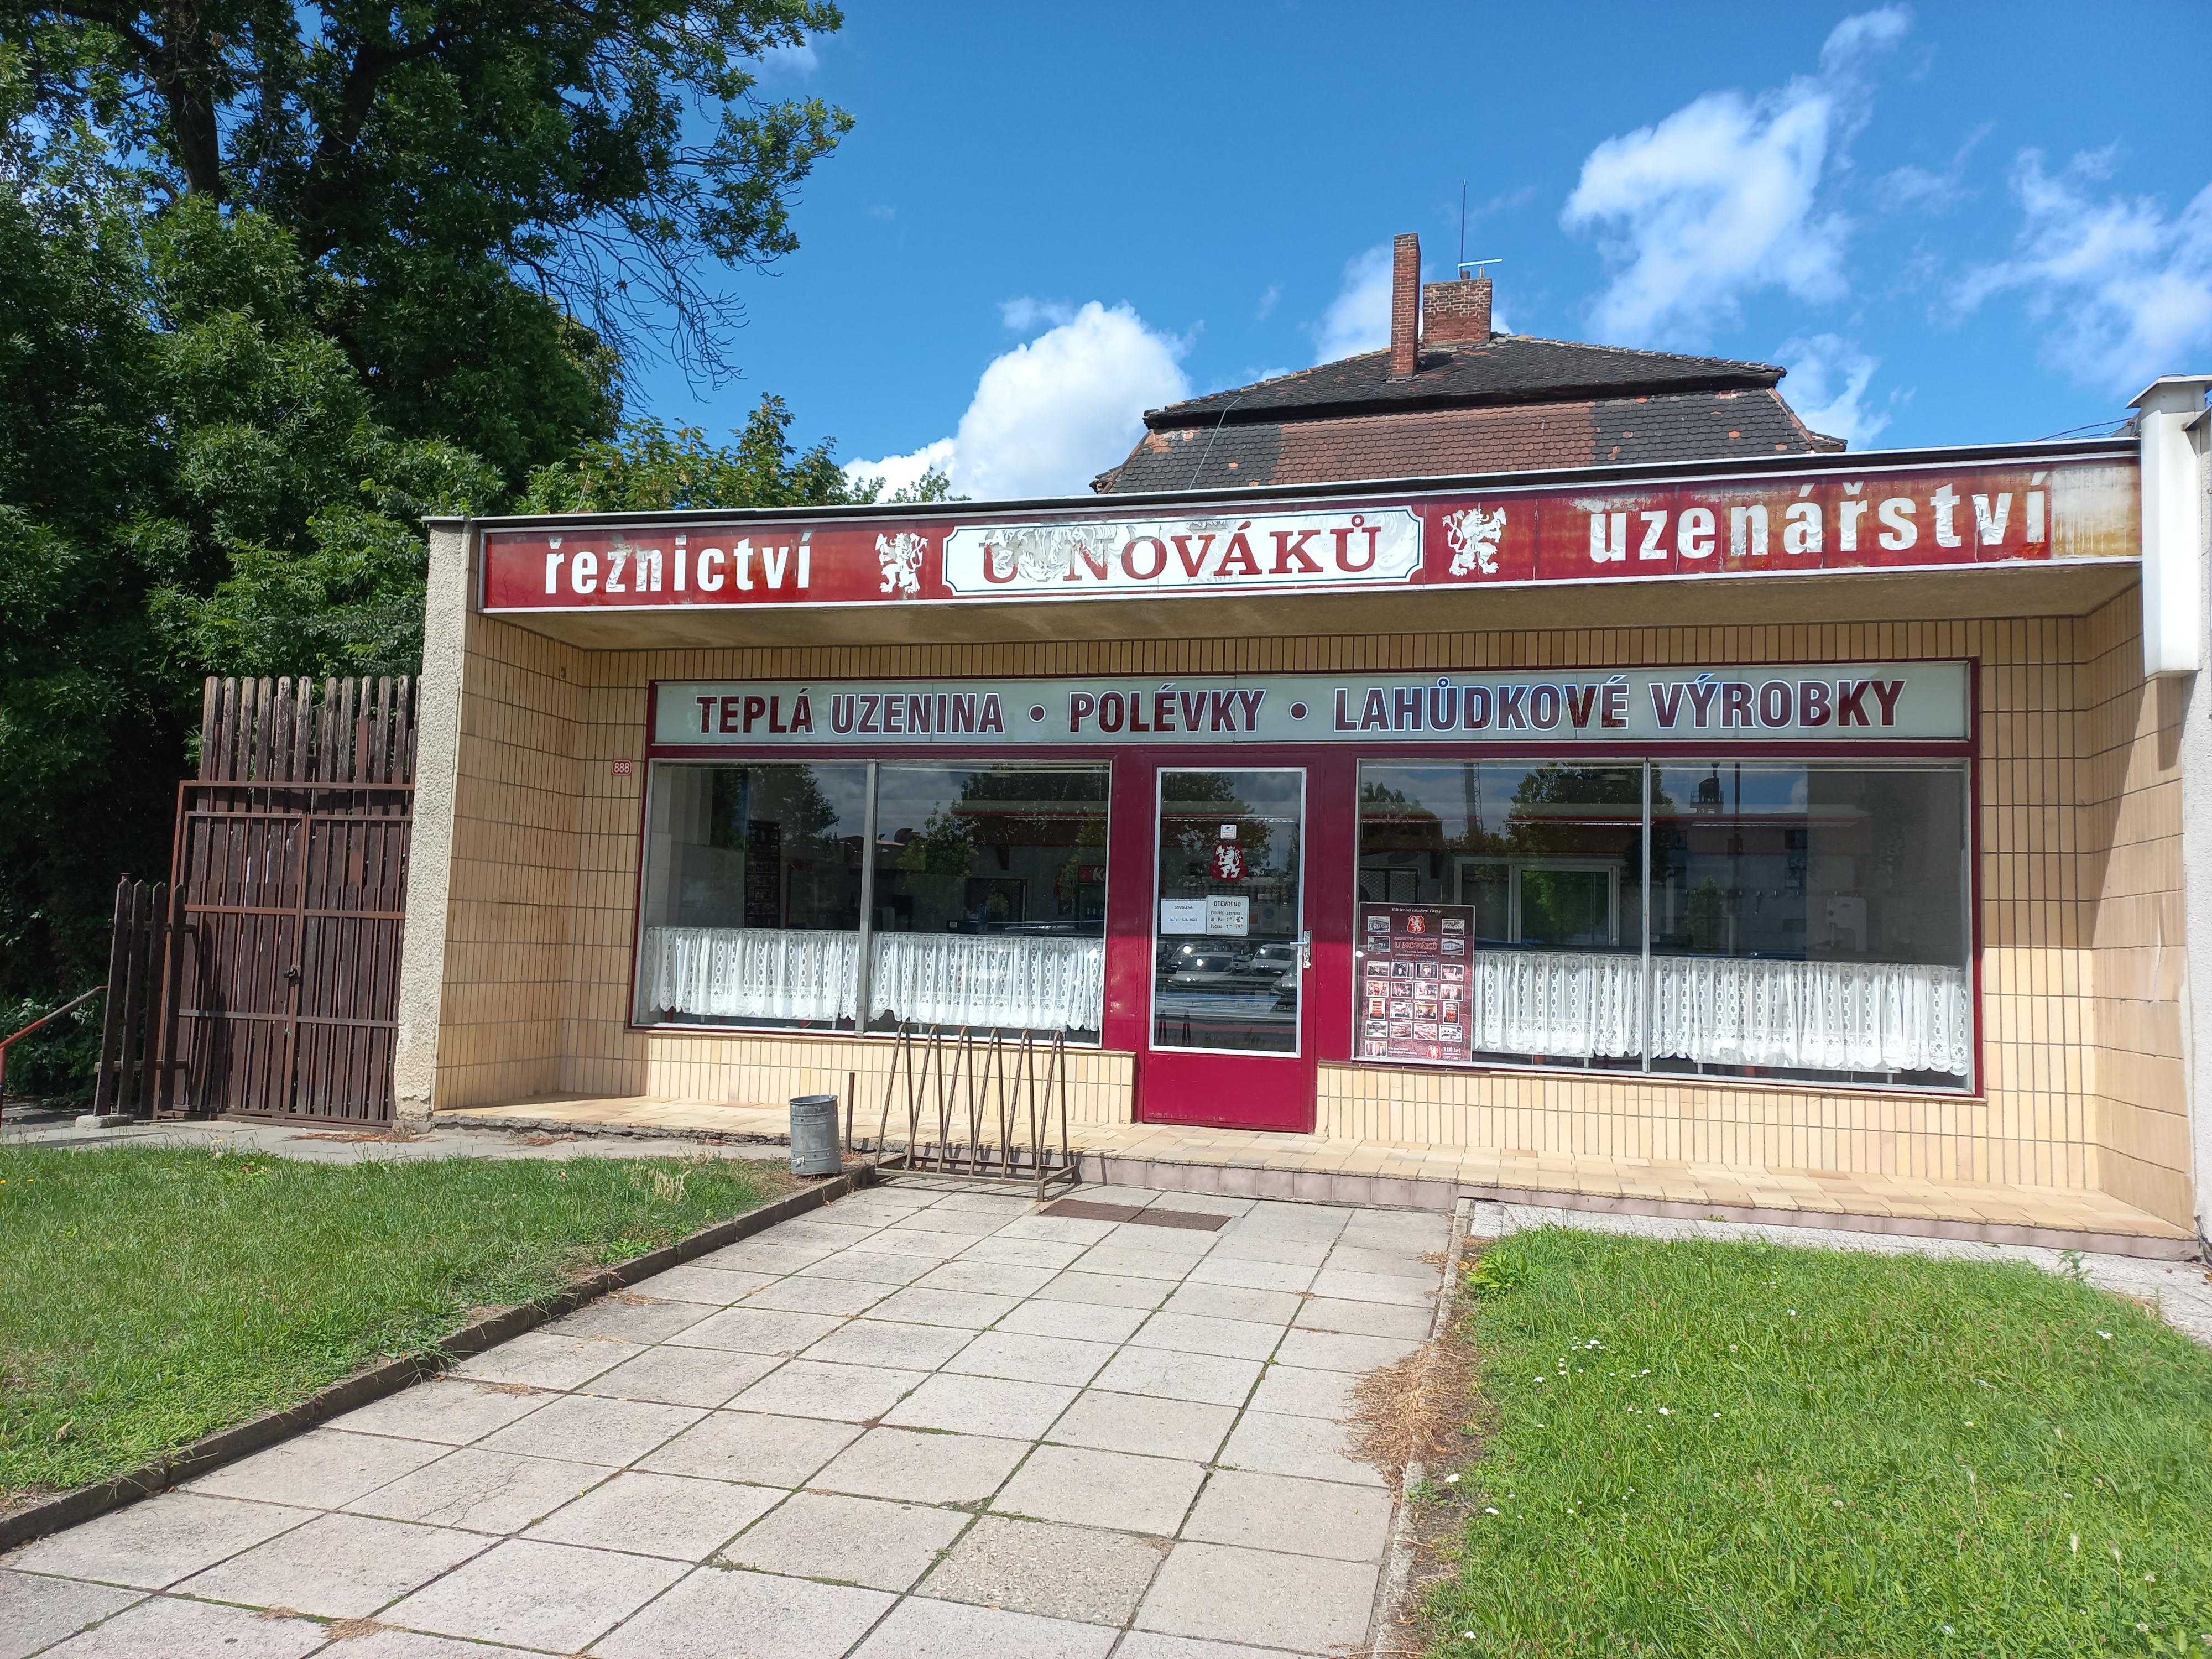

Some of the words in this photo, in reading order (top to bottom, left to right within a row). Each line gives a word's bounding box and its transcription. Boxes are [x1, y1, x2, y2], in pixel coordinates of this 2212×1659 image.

[979, 541, 1022, 584] U
[1063, 514, 1382, 582] NOVÁKŮ
[1589, 471, 2047, 563] uzenářství
[545, 529, 816, 594] řeznictví
[696, 687, 815, 734] TEPLÁ
[830, 693, 1005, 735] UZENINA
[1068, 682, 1267, 734] POLÉVKY
[1333, 675, 1630, 732] LAHŮDKOVÉ
[1648, 673, 1908, 729] VÝROBKY
[614, 762, 630, 773] 888
